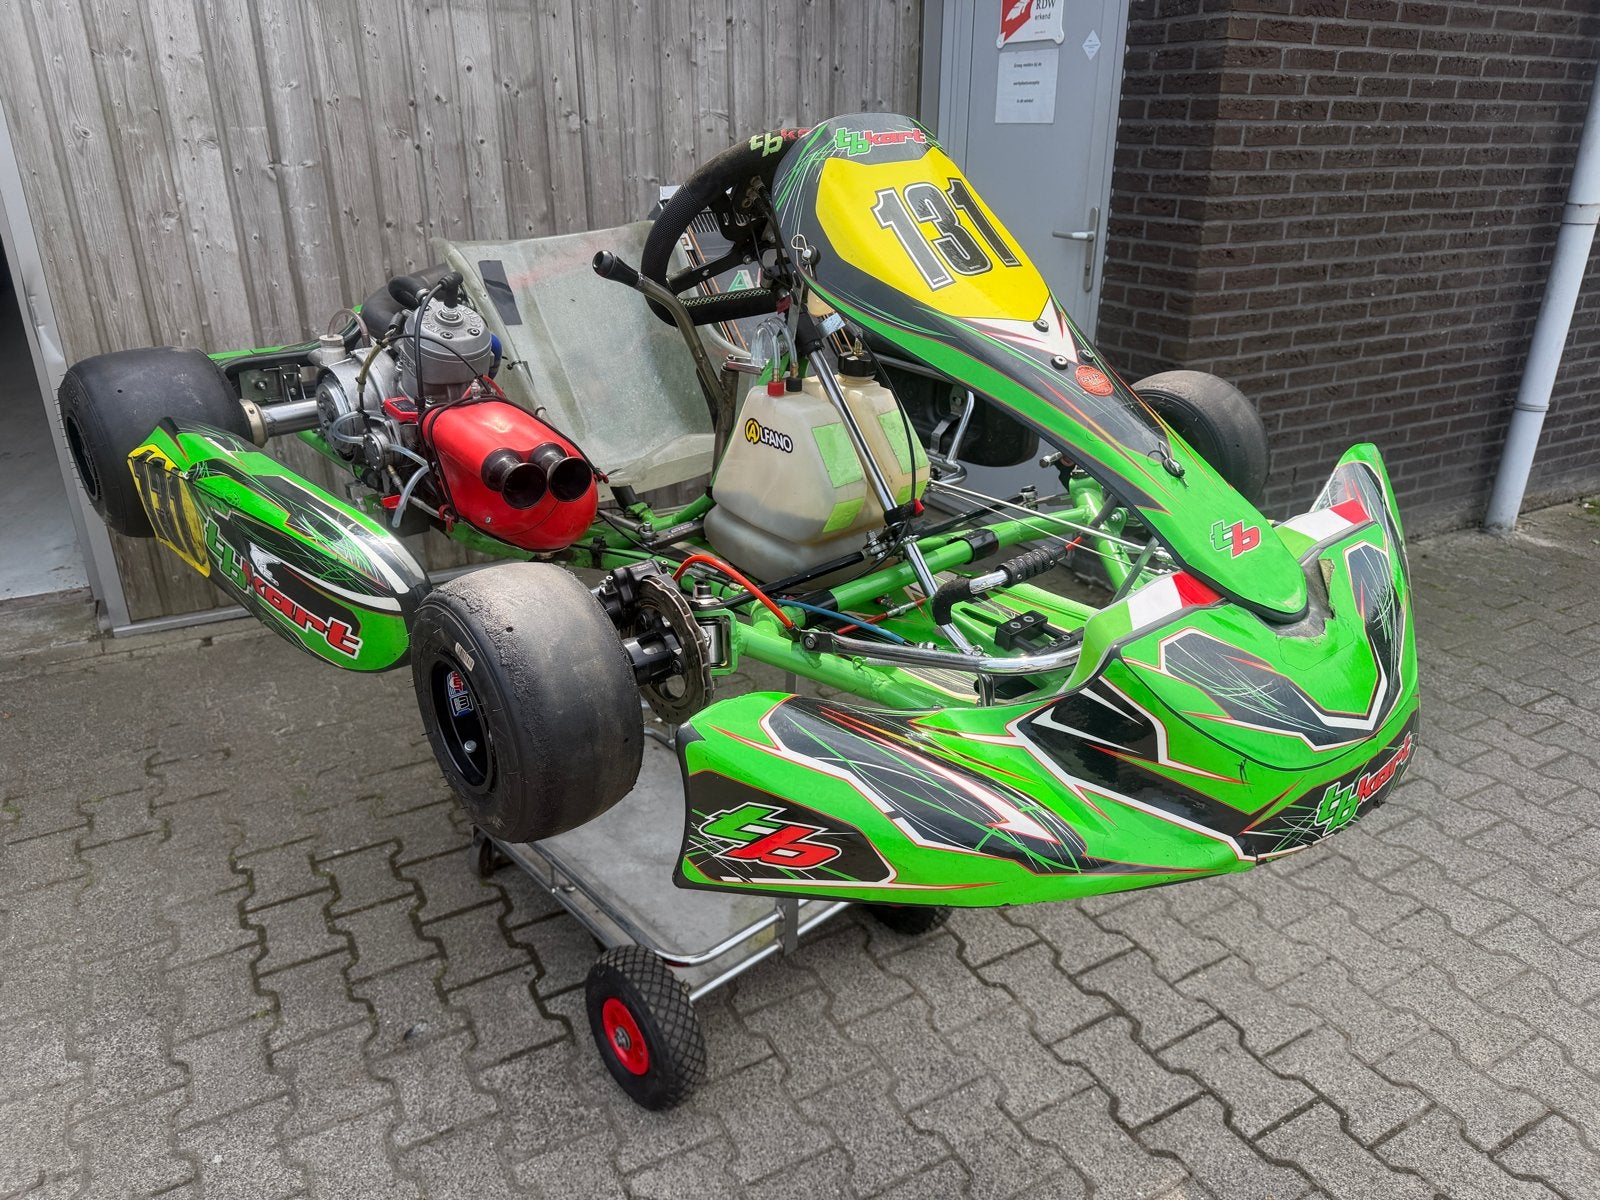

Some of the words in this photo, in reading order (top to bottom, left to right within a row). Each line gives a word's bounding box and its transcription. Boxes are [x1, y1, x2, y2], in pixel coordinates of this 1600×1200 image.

[870, 177, 1022, 292] 131
[745, 418, 794, 453] ALFANO
[1210, 518, 1261, 560] tb
[699, 801, 842, 870] tb
